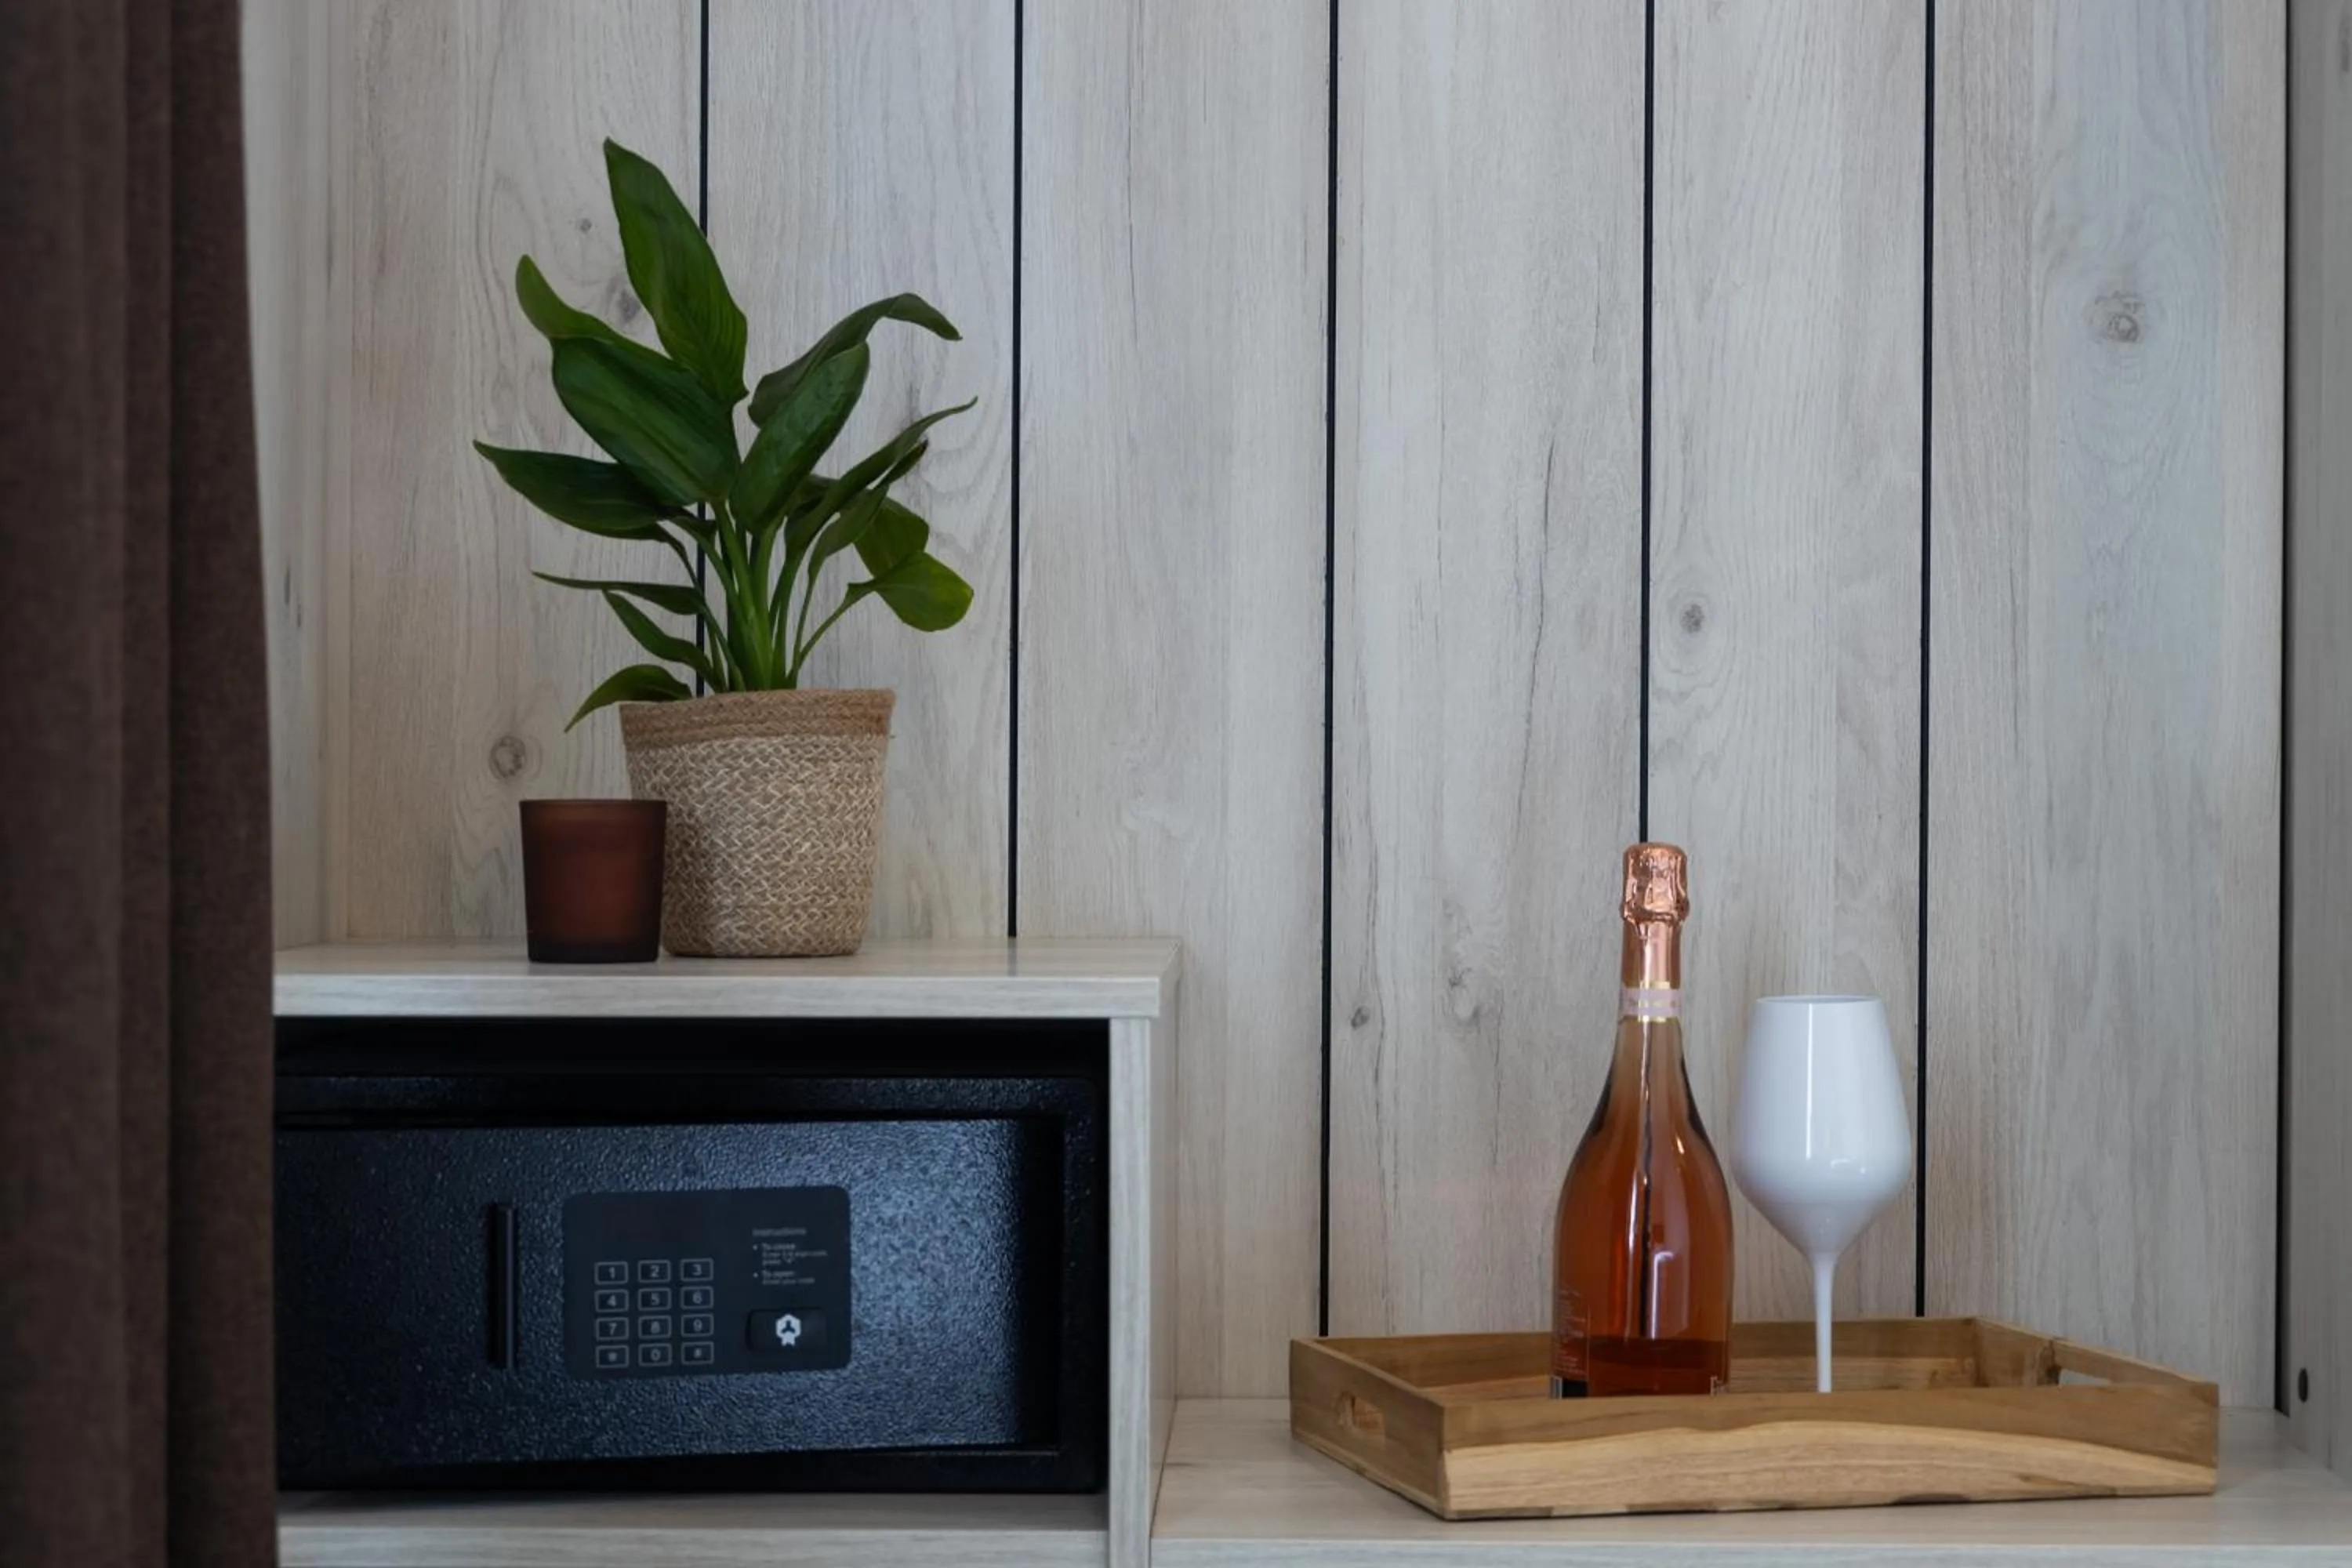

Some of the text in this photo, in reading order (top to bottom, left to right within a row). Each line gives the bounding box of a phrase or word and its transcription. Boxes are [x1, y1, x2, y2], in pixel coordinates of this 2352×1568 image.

[608, 1264, 702, 1279] 1 2 3
[607, 1291, 702, 1307] 4 5 6
[608, 1319, 702, 1335] 7 8 9
[650, 1348, 661, 1361] 0
